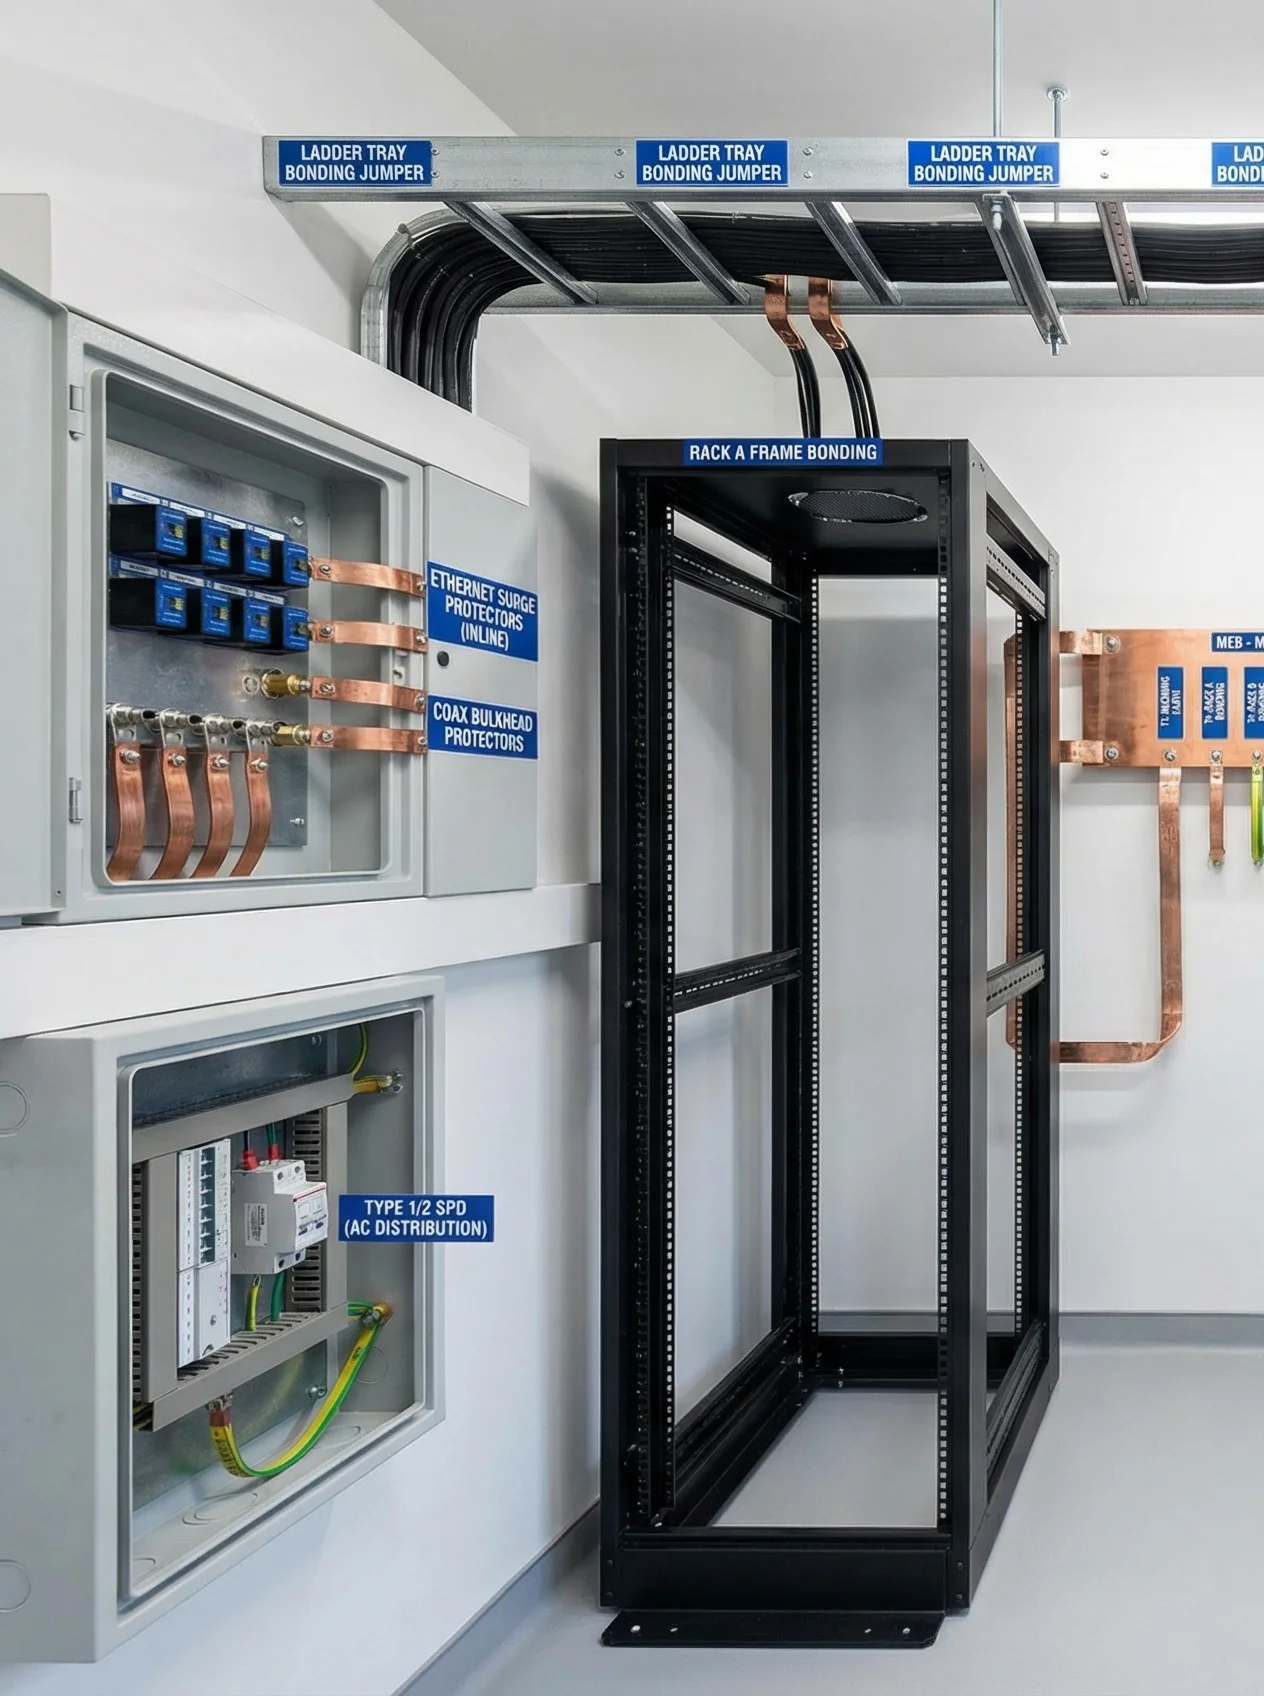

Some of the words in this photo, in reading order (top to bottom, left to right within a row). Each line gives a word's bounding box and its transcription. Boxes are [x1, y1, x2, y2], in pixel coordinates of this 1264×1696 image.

[301, 144, 363, 161] LADDER
[366, 144, 407, 161] TRAY
[658, 144, 721, 161] LADDER
[724, 144, 765, 161] TRAY
[931, 144, 993, 162] LADDER
[996, 144, 1038, 162] TRAY
[285, 164, 356, 181] BONDING
[359, 164, 424, 181] JUMPER
[642, 164, 713, 182] BONDING
[716, 164, 782, 182] JUMPER
[914, 164, 985, 182] BONDING
[988, 164, 1054, 182] JUMPER
[690, 444, 731, 460] RACK
[734, 444, 746, 460] A
[750, 444, 803, 460] FRAME
[807, 444, 877, 460] BONDING
[431, 568, 495, 602] ETHERNET
[497, 588, 536, 614] SURGE
[445, 595, 524, 631] PROTECTORS
[460, 622, 509, 652] (INLINE)
[1216, 635, 1243, 650] MEB
[433, 702, 469, 724] COAX
[471, 707, 533, 732] BULKHEAD
[445, 726, 524, 752] PROTECTORS
[364, 1199, 404, 1217] TYPE
[409, 1199, 431, 1217] 1/2
[435, 1199, 467, 1217] SPD
[344, 1219, 371, 1240] (AC
[375, 1219, 487, 1240] DISTRIBUTION)
